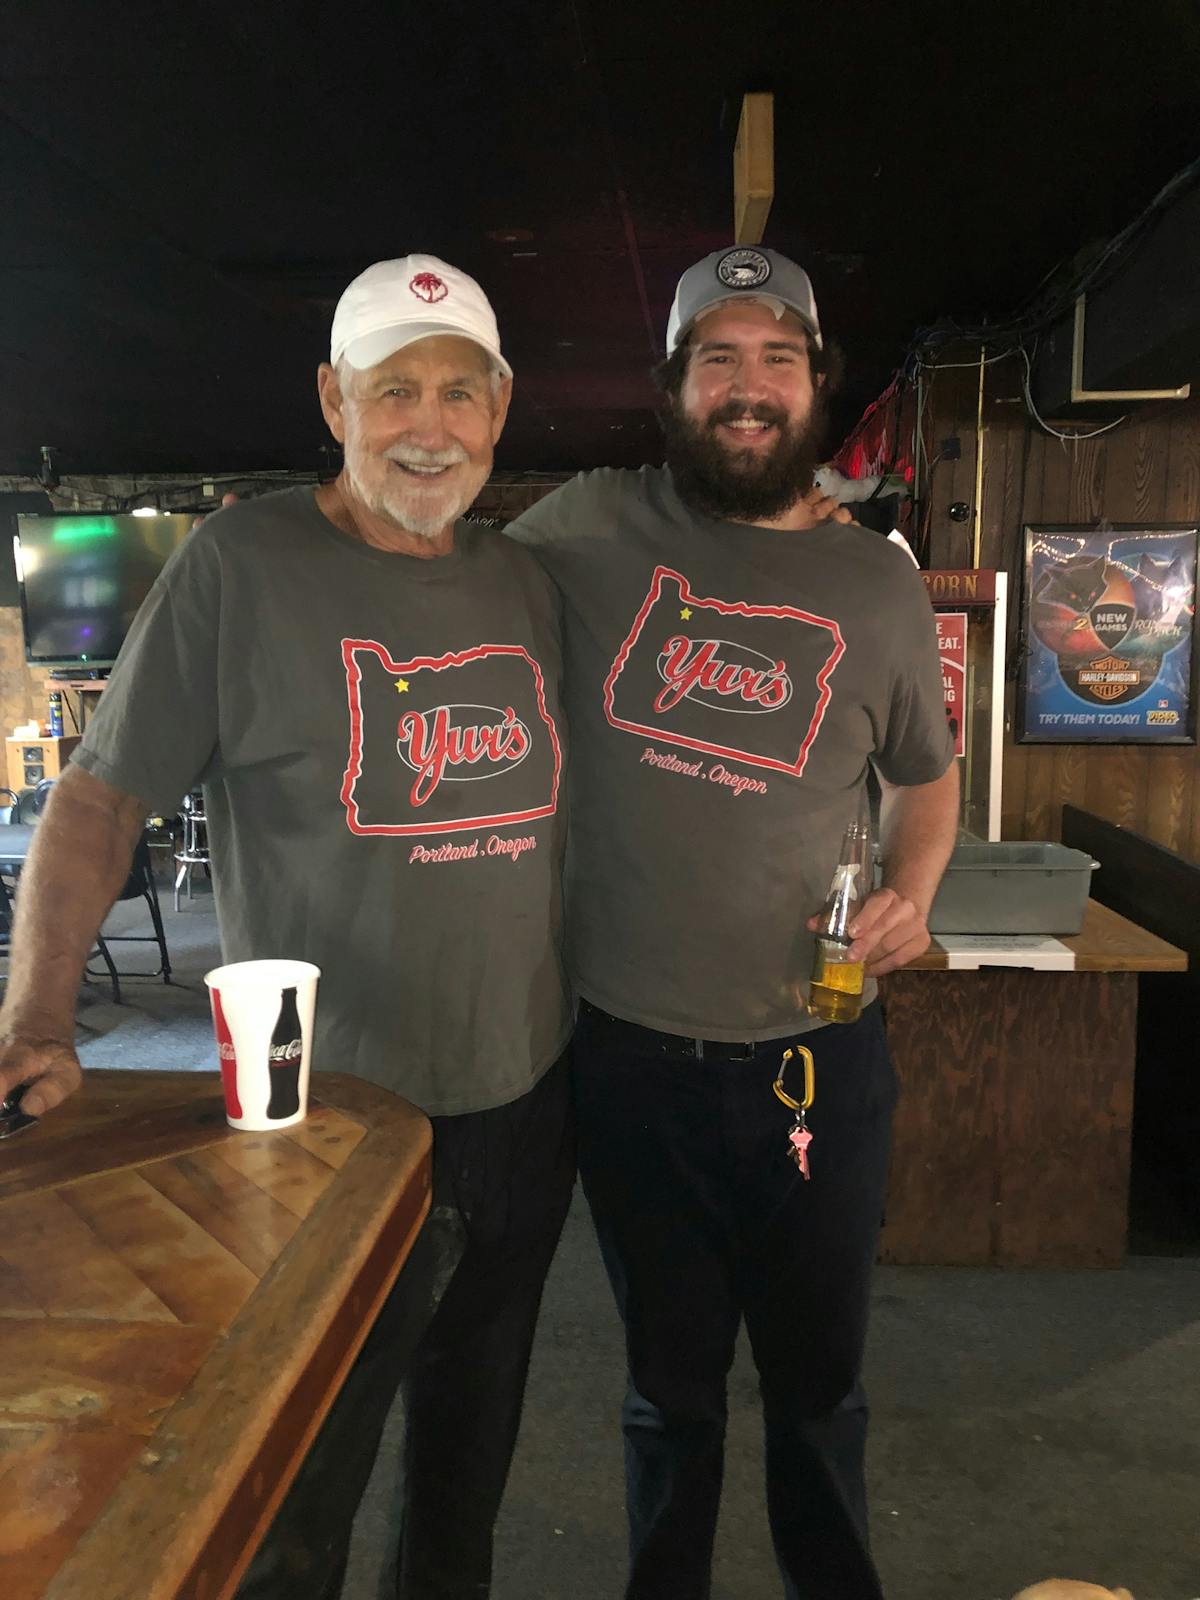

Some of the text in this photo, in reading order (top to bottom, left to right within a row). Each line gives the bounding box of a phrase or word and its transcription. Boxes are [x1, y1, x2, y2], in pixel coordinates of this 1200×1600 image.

[1094, 623, 1127, 632] GAMES
[1096, 613, 1127, 623] NEW
[653, 635, 788, 714] Yur's
[1039, 713, 1061, 724] TRY
[1063, 713, 1095, 724] THEM
[1097, 713, 1140, 724] TODAY!
[397, 706, 528, 808] Yur's
[709, 764, 767, 796] Oregon
[487, 834, 537, 862] Oregon
